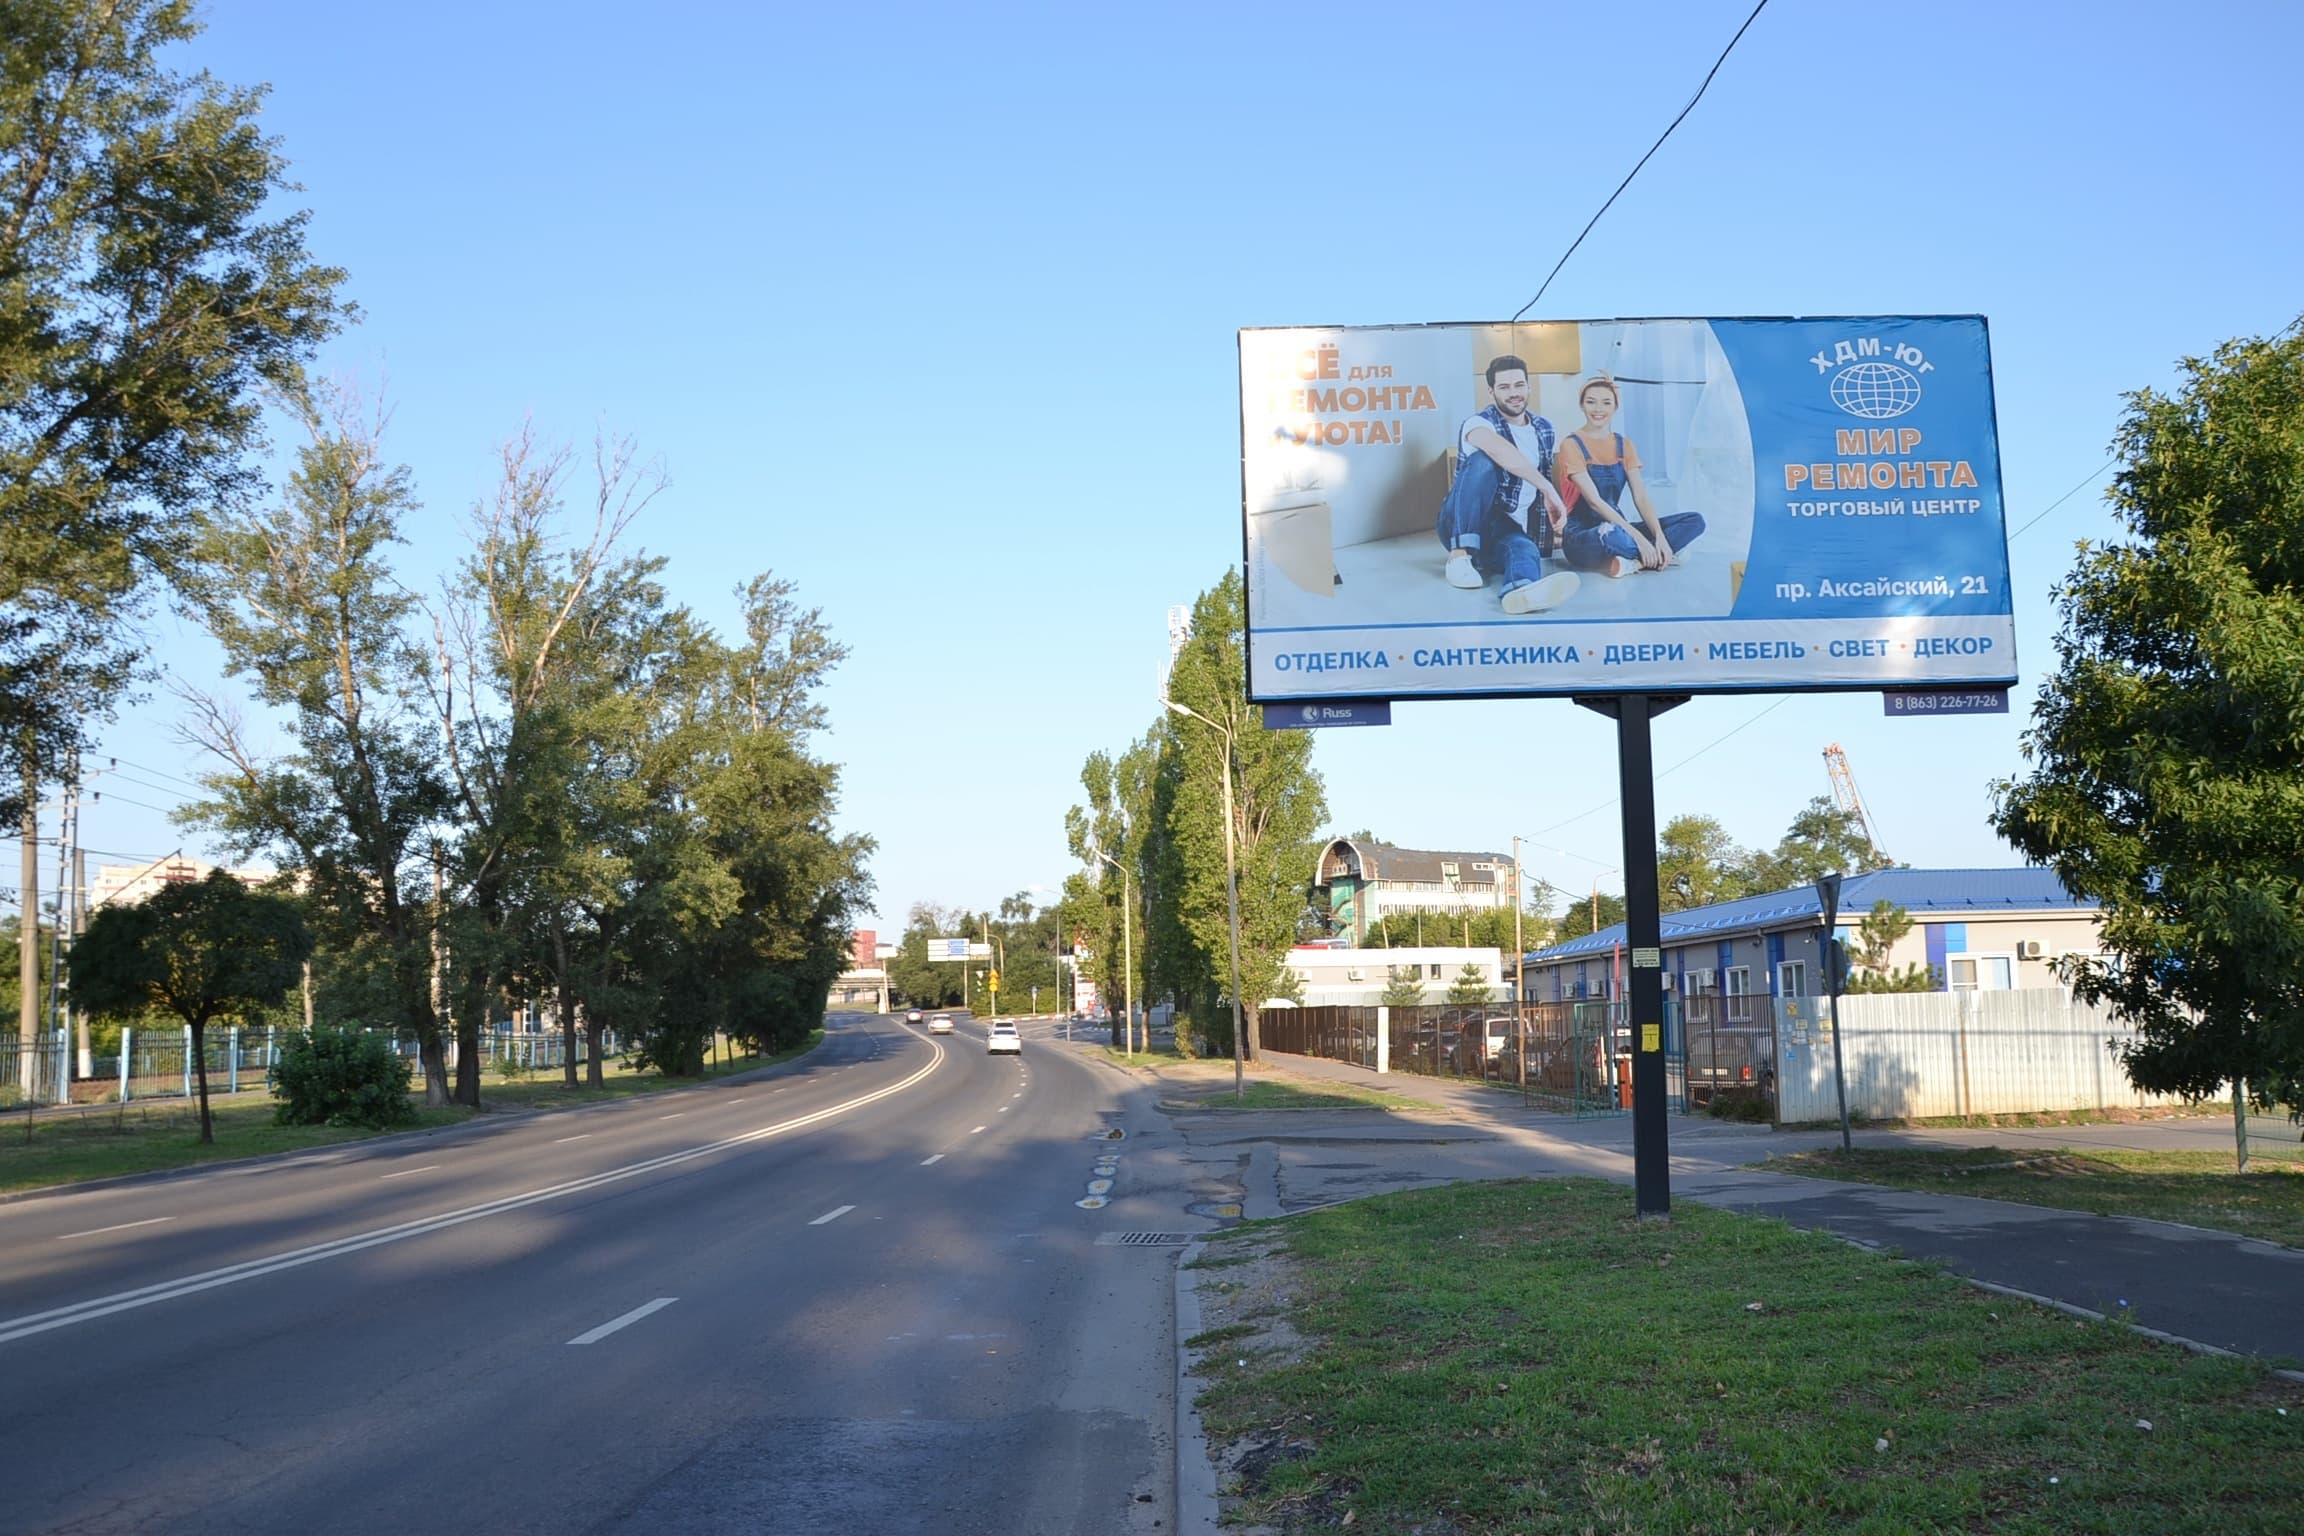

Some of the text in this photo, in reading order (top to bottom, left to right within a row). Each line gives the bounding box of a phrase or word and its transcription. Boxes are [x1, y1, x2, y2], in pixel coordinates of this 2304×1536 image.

[1347, 365, 1393, 381] для
[1836, 428, 1922, 455] МИР
[1784, 461, 1979, 490] РЕМОНТА
[1786, 497, 1982, 517] ТОРГОВЫЙ ЦЕНТР
[1776, 575, 1989, 602] пр. Аксайский, 21
[1274, 637, 1993, 672] ОТДЕЛКА САНТЕХНИКА ДВЕРИ МЕБЕЛЬ СВЕТ ДЕКОР
[1322, 707, 1353, 719] Russ
[1895, 694, 1999, 710] 8 (863) 226-77-26
